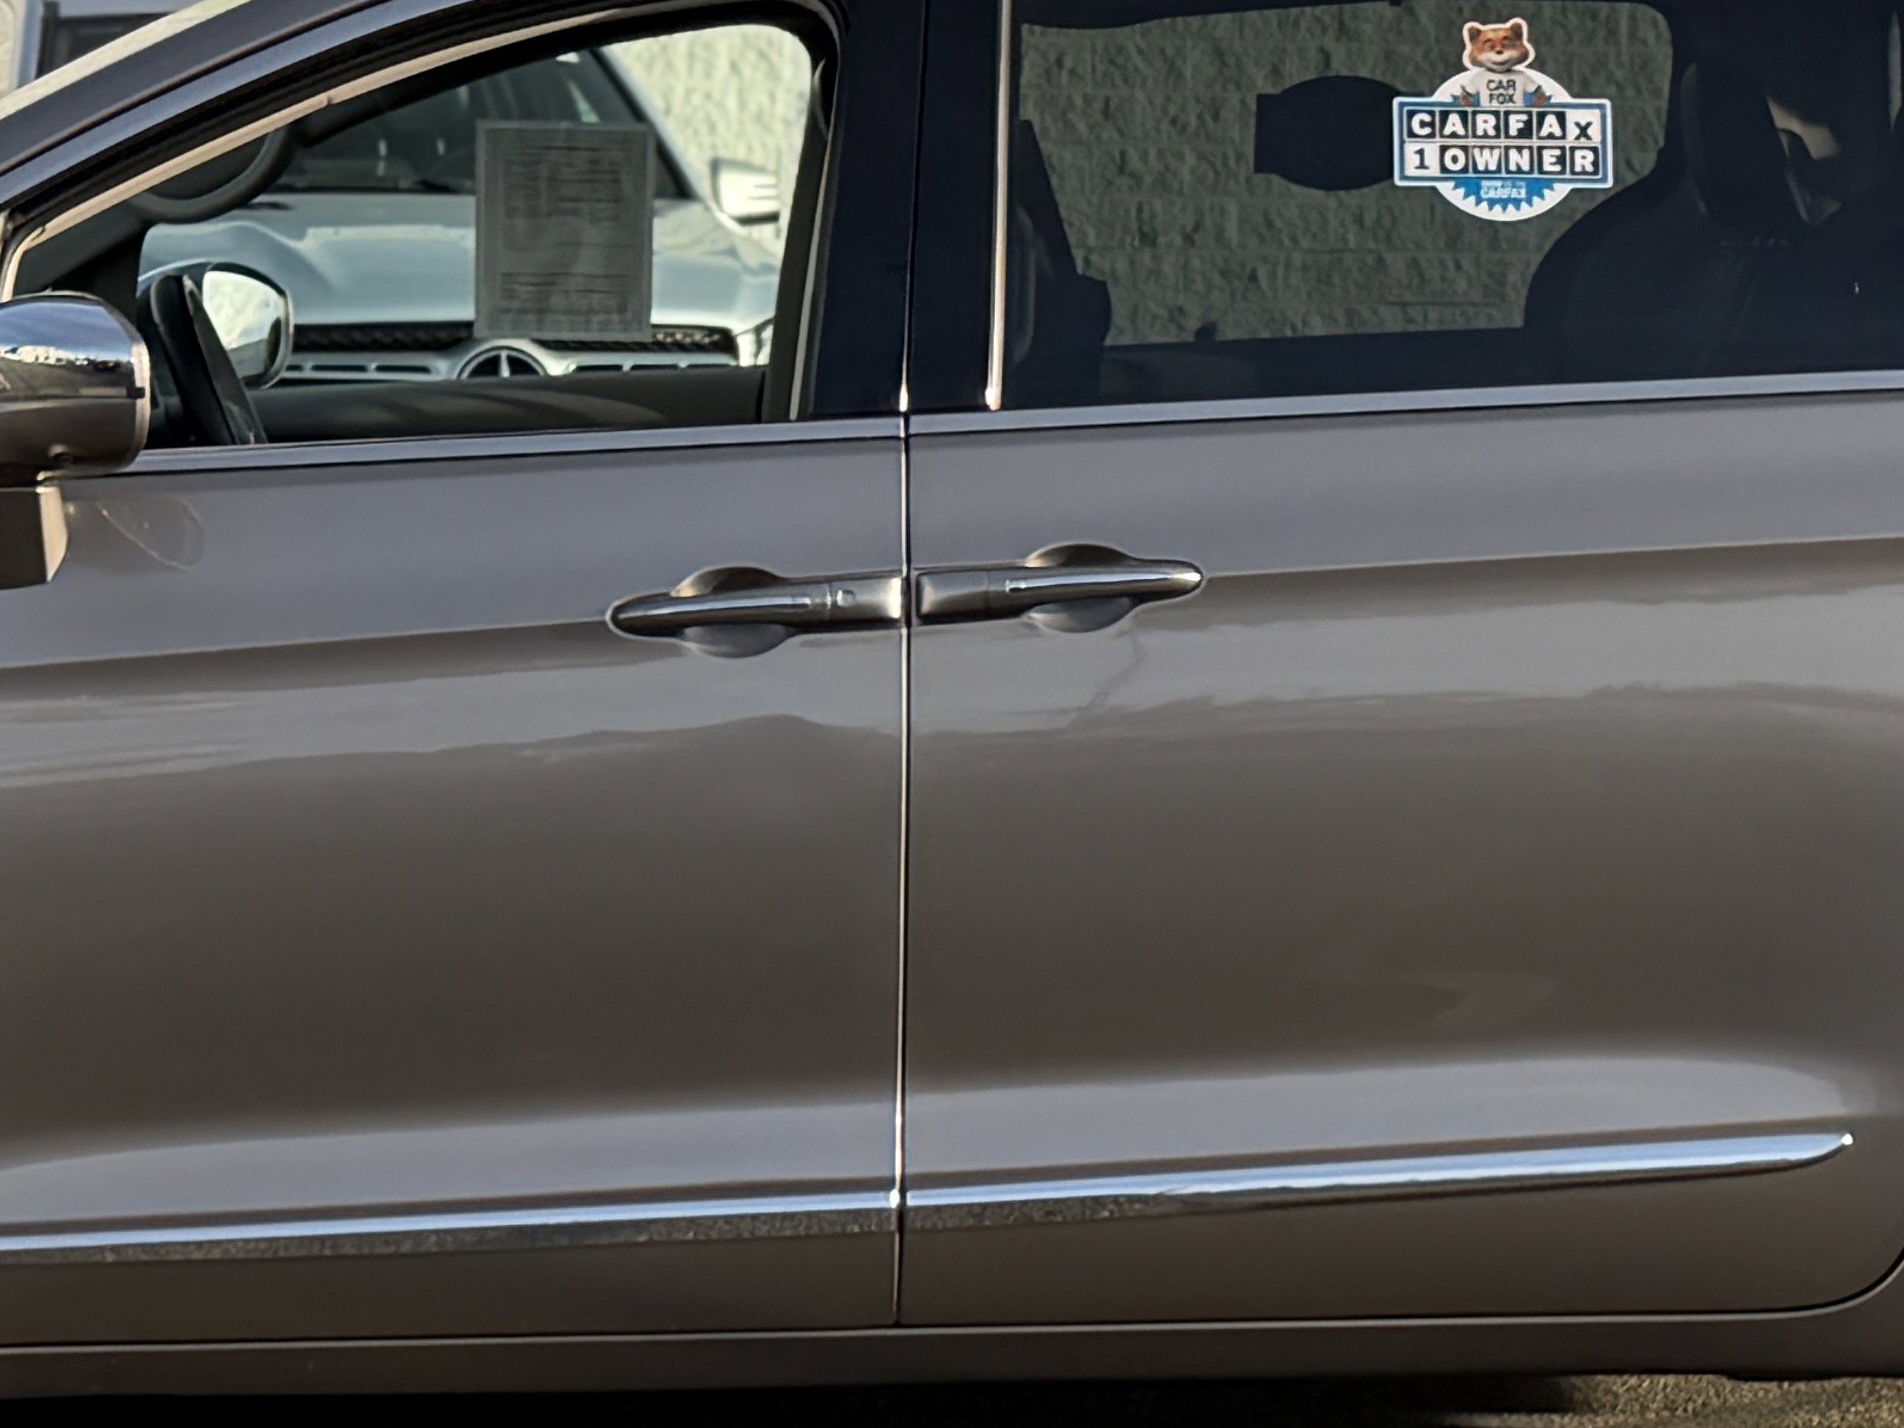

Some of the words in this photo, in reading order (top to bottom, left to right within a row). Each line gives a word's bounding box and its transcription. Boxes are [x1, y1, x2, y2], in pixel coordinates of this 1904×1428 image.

[1486, 78, 1516, 92] CAR
[1488, 92, 1516, 105] FOX
[1410, 112, 1594, 141] CARFAX
[1413, 147, 1430, 171] 1
[1443, 147, 1596, 173] OWNER
